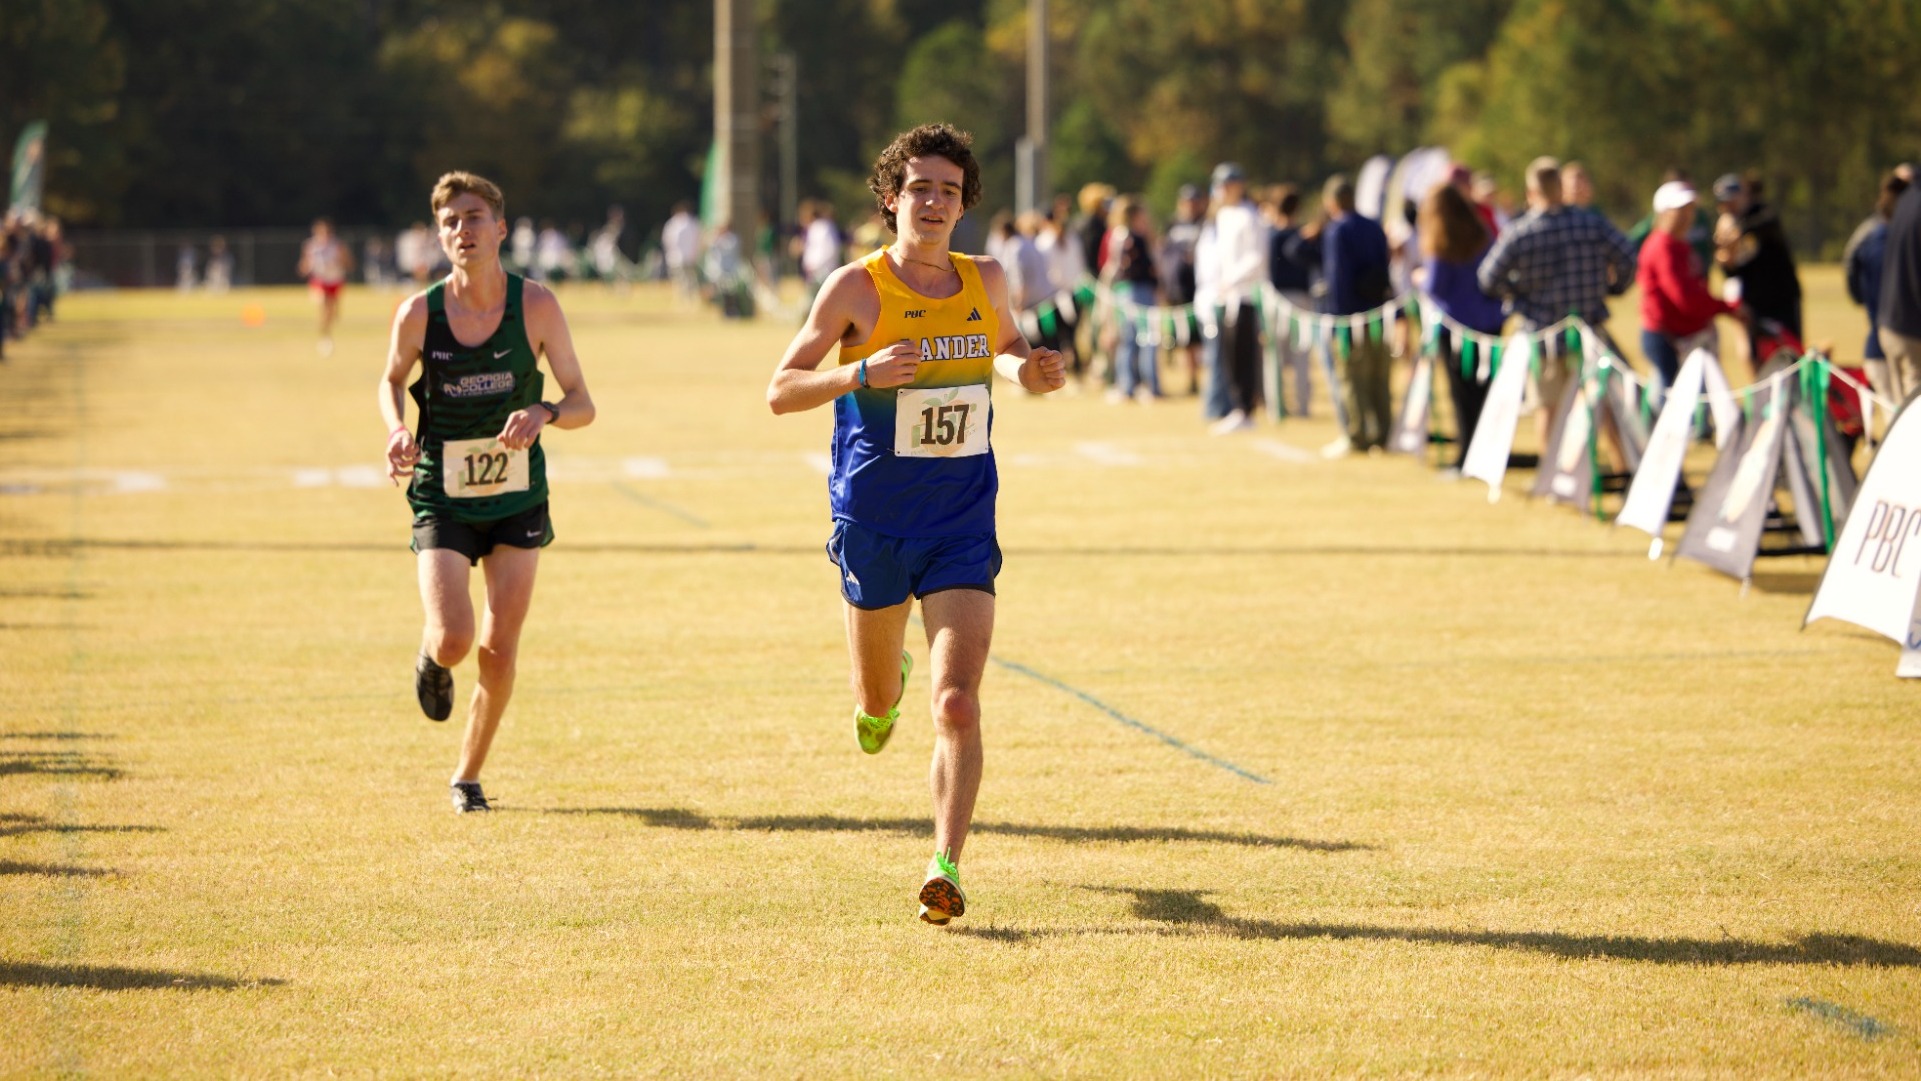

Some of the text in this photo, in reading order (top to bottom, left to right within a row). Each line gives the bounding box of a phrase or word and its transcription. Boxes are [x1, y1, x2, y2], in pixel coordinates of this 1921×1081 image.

[904, 310, 927, 319] PBC
[900, 333, 991, 362] ANDER
[460, 371, 513, 386] GEORGIA
[462, 380, 515, 393] COLLEGE
[920, 403, 970, 446] 157
[464, 452, 509, 486] 122
[1854, 499, 1921, 579] PBC
